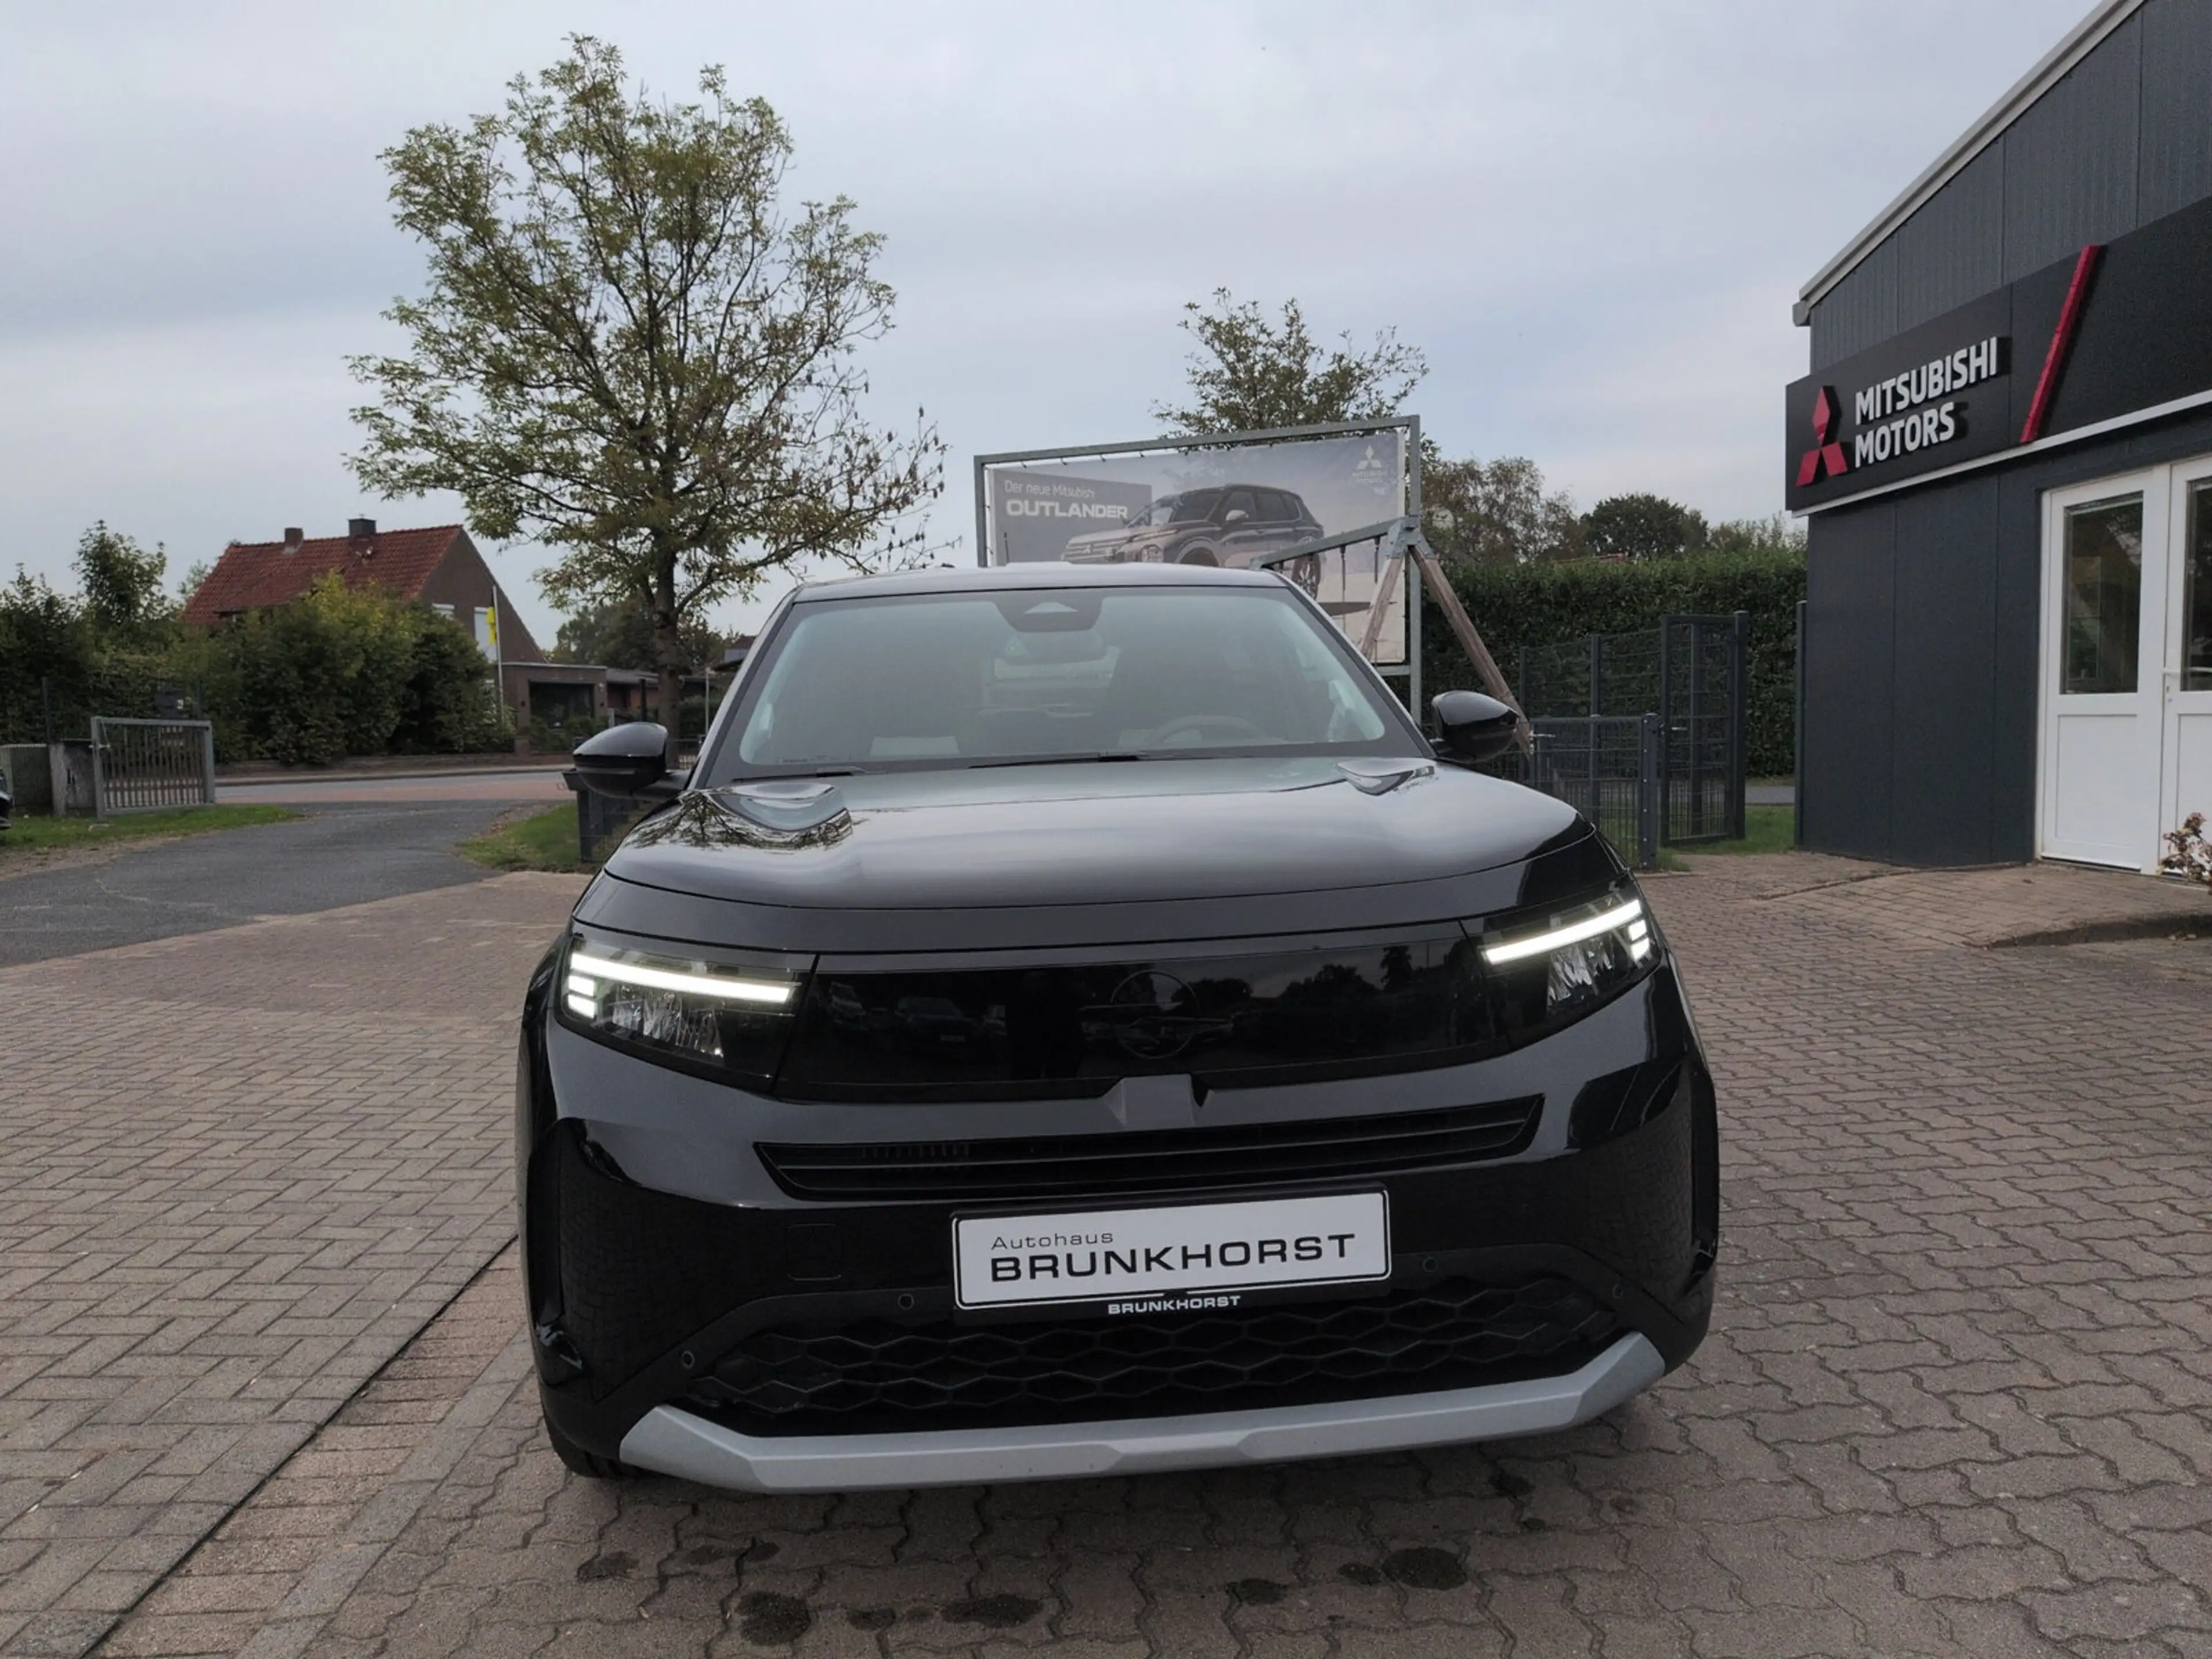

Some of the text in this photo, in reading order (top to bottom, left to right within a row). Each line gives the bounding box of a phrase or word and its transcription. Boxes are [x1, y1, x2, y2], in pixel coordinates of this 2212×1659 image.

[1855, 336, 1997, 425] MITSUBISHI
[1855, 402, 1955, 468] MOTORS
[1005, 479, 1023, 494] Der
[1027, 483, 1051, 496] neue
[1006, 499, 1128, 518] OUTLANDER
[991, 1233, 1113, 1251] Autohaus
[991, 1233, 1355, 1282] BRUNKHORST
[1108, 1295, 1241, 1315] BRUNKHORST
